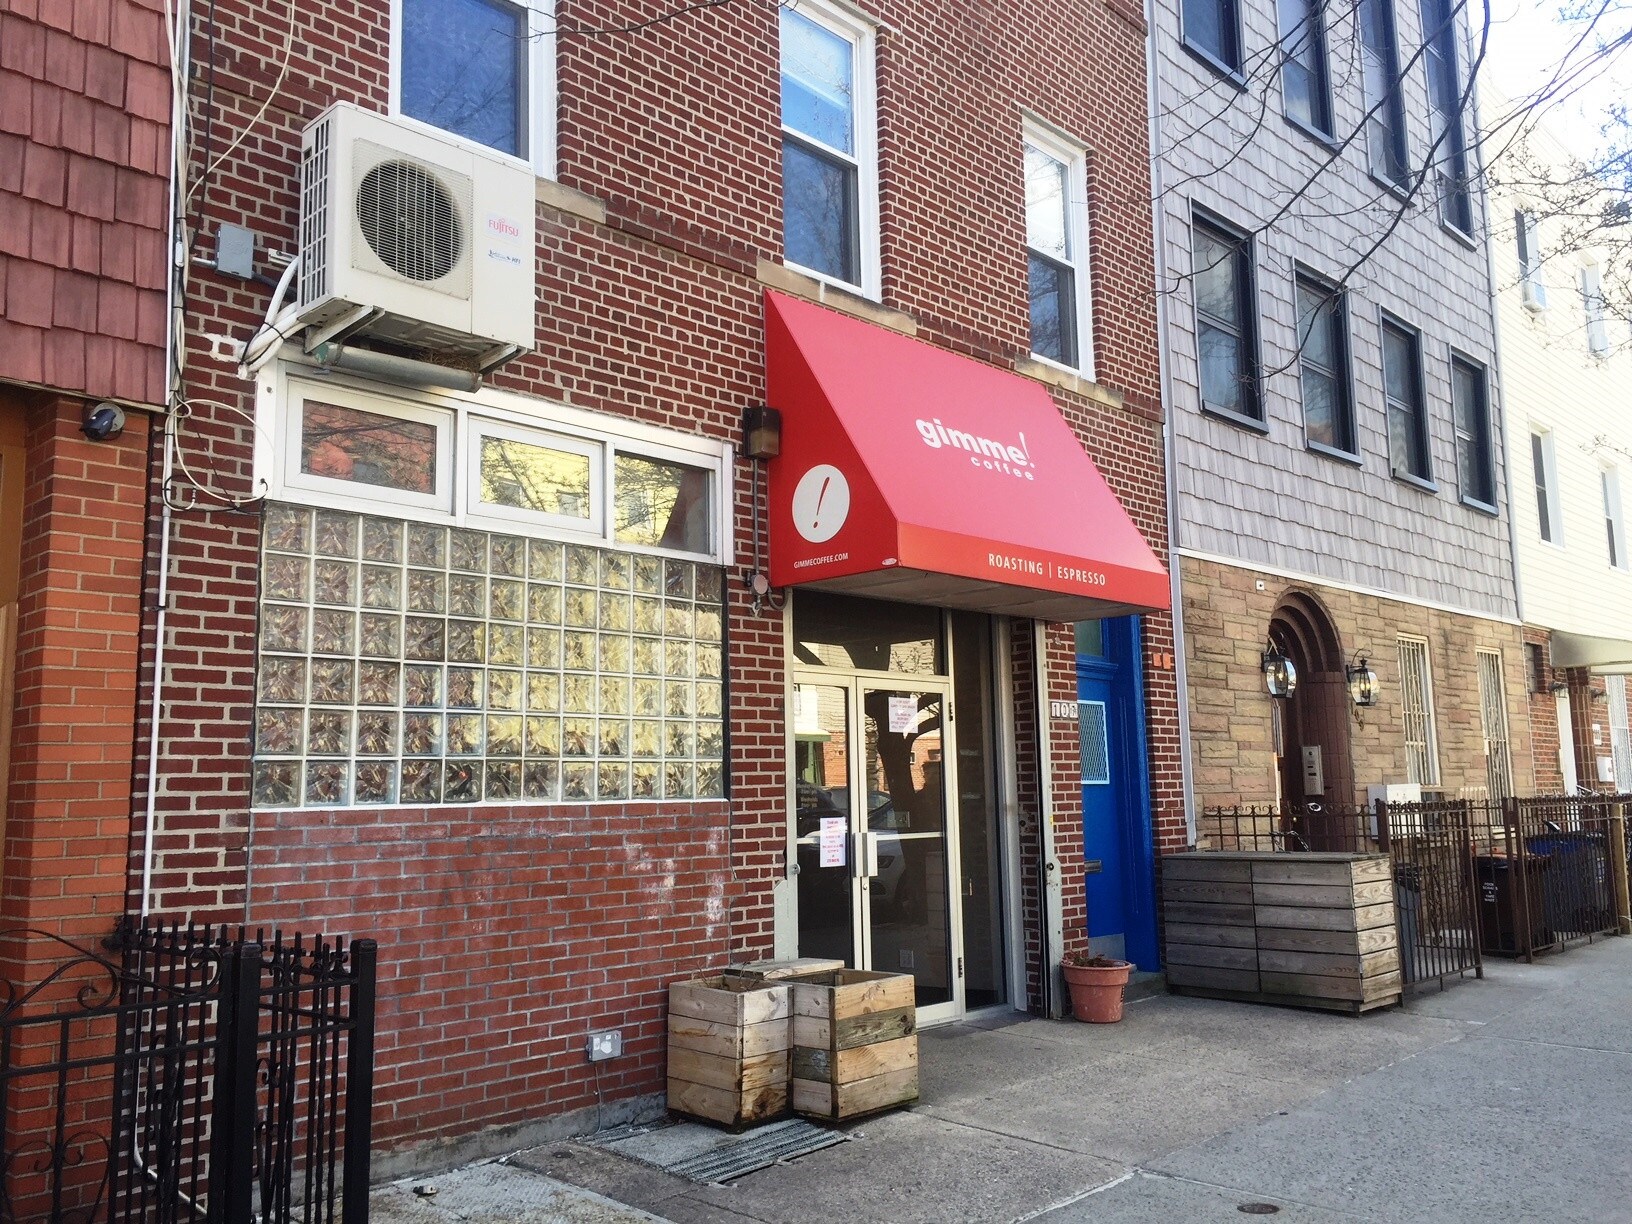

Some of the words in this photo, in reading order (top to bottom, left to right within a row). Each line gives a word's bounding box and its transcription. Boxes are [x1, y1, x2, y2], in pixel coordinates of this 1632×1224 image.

[488, 217, 519, 237] FUJITSU
[915, 418, 1035, 469] gimme!
[970, 456, 1034, 481] coffee
[793, 552, 849, 569] GIMMECOFFEE.COM
[988, 553, 1043, 576] ROASTING
[1057, 566, 1106, 586] ESPRESSO
